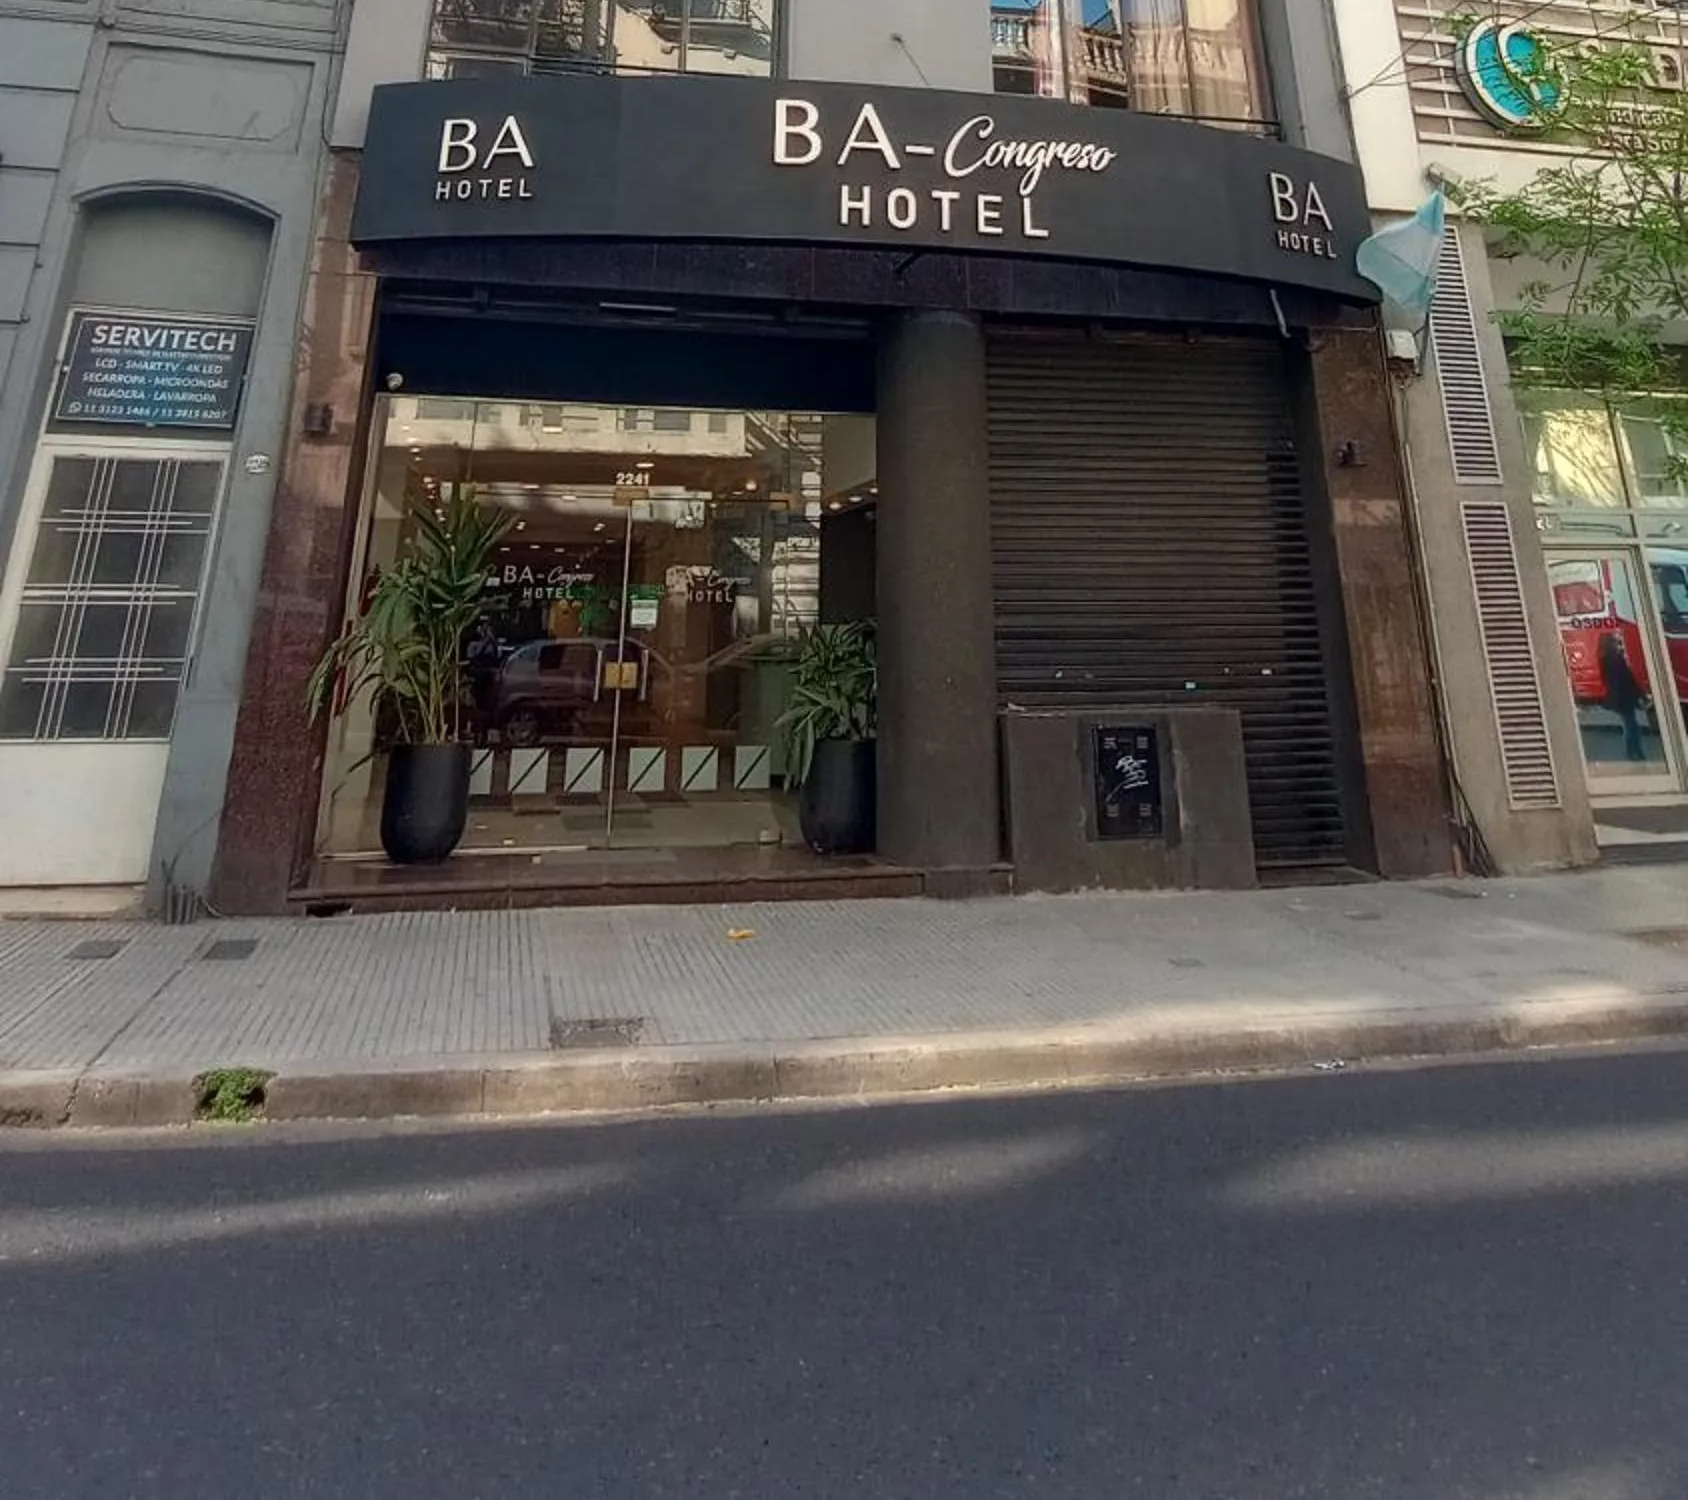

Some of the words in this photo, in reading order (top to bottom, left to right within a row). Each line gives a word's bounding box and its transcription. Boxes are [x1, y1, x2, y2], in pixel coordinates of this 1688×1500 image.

[437, 115, 534, 172] BA
[435, 178, 533, 200] HOTEL
[1270, 171, 1333, 231] BA
[840, 184, 1050, 238] HOTEL
[1277, 229, 1338, 259] HOTEL
[91, 324, 237, 352] SERVITECH
[95, 357, 118, 369] LCD
[126, 360, 162, 371] SMART
[202, 364, 223, 375] LED
[615, 472, 649, 486] 2241
[522, 587, 575, 599] HOTEL
